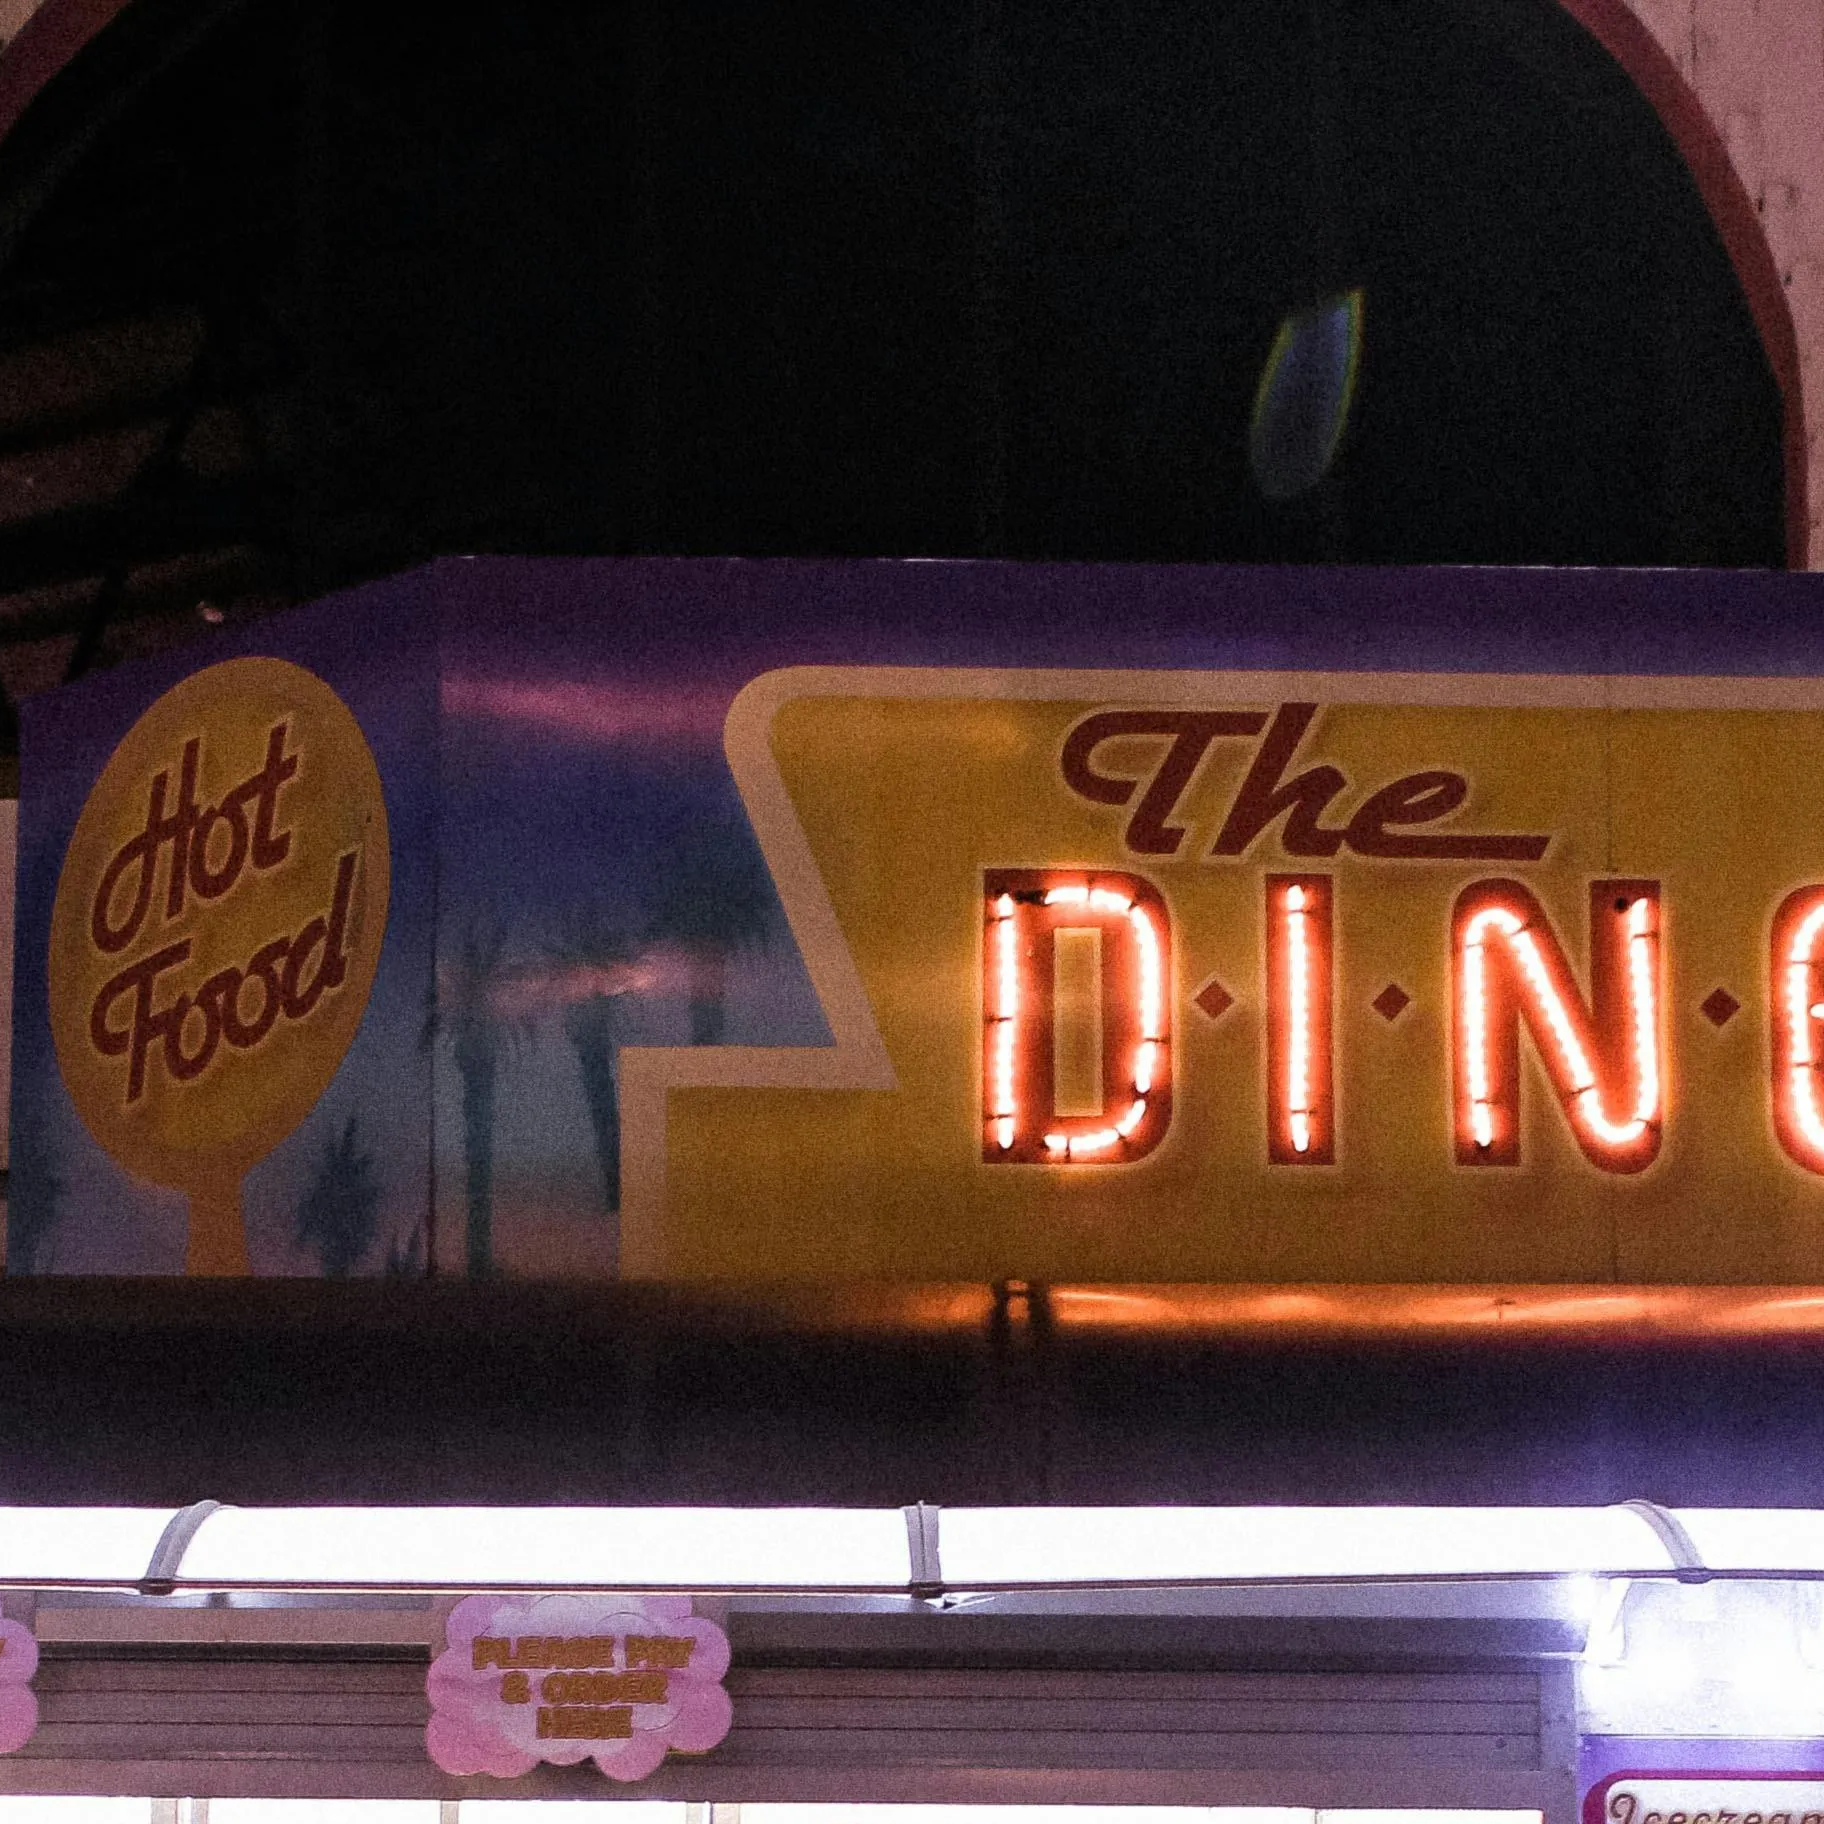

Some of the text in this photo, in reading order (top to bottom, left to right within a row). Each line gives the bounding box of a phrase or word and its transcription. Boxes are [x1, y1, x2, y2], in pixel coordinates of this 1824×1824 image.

[92, 723, 298, 954] Hot
[1060, 701, 1553, 861] The
[90, 851, 359, 1104] Food
